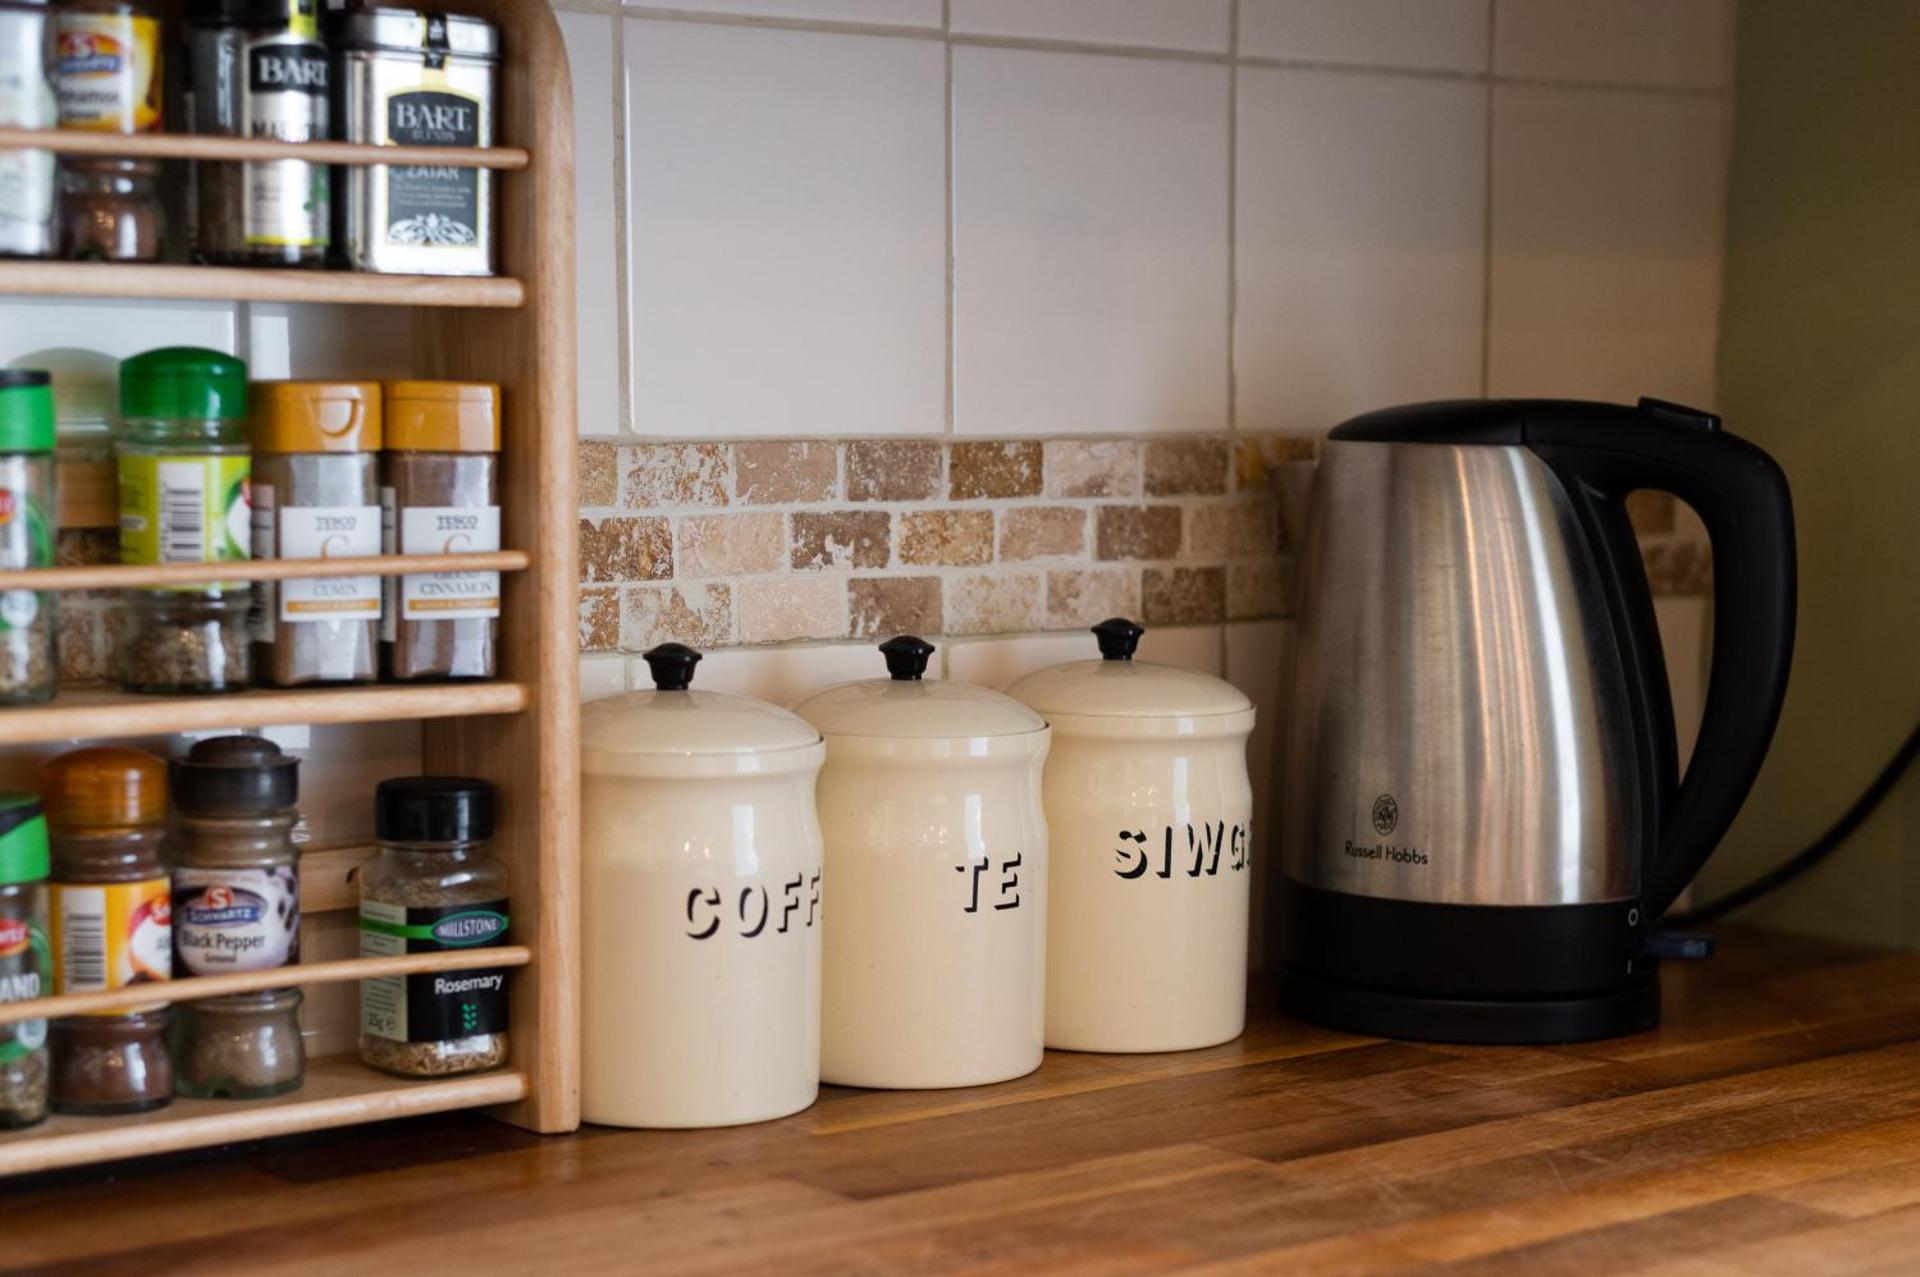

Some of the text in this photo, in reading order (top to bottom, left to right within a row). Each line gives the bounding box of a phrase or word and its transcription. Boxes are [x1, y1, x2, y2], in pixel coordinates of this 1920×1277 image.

[396, 102, 471, 132] BART
[315, 515, 357, 528] TESCO
[436, 515, 478, 528] TESCO
[419, 581, 493, 596] CINNAMON
[1345, 840, 1429, 865] Russell Hobbs
[955, 851, 1022, 913] TE
[686, 867, 823, 940] COFF
[438, 918, 499, 938] MILLSTONE
[182, 930, 213, 948] Black
[216, 933, 265, 952] Pepper
[434, 974, 503, 995] Rosemary
